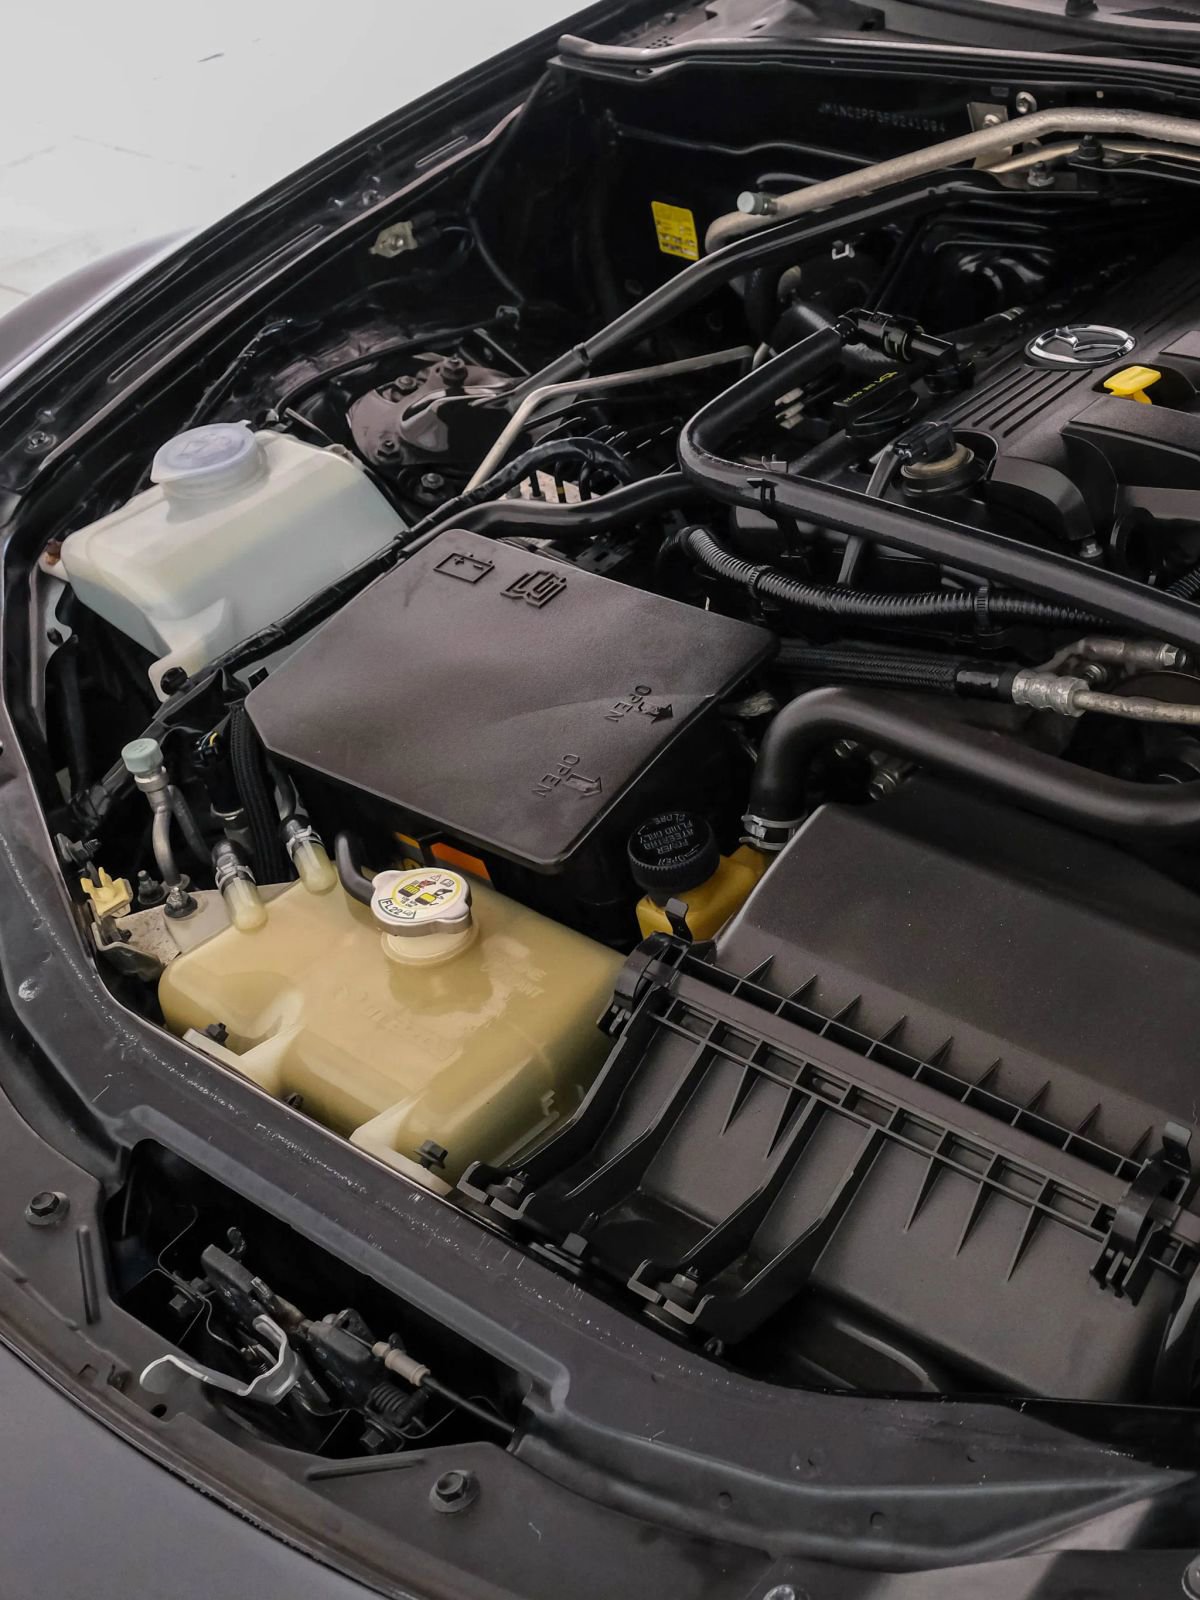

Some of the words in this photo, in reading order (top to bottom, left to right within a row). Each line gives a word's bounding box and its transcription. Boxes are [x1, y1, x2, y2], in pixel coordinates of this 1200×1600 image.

[604, 684, 652, 723] OPEN
[531, 753, 580, 798] OPEN
[382, 899, 403, 916] FL22
